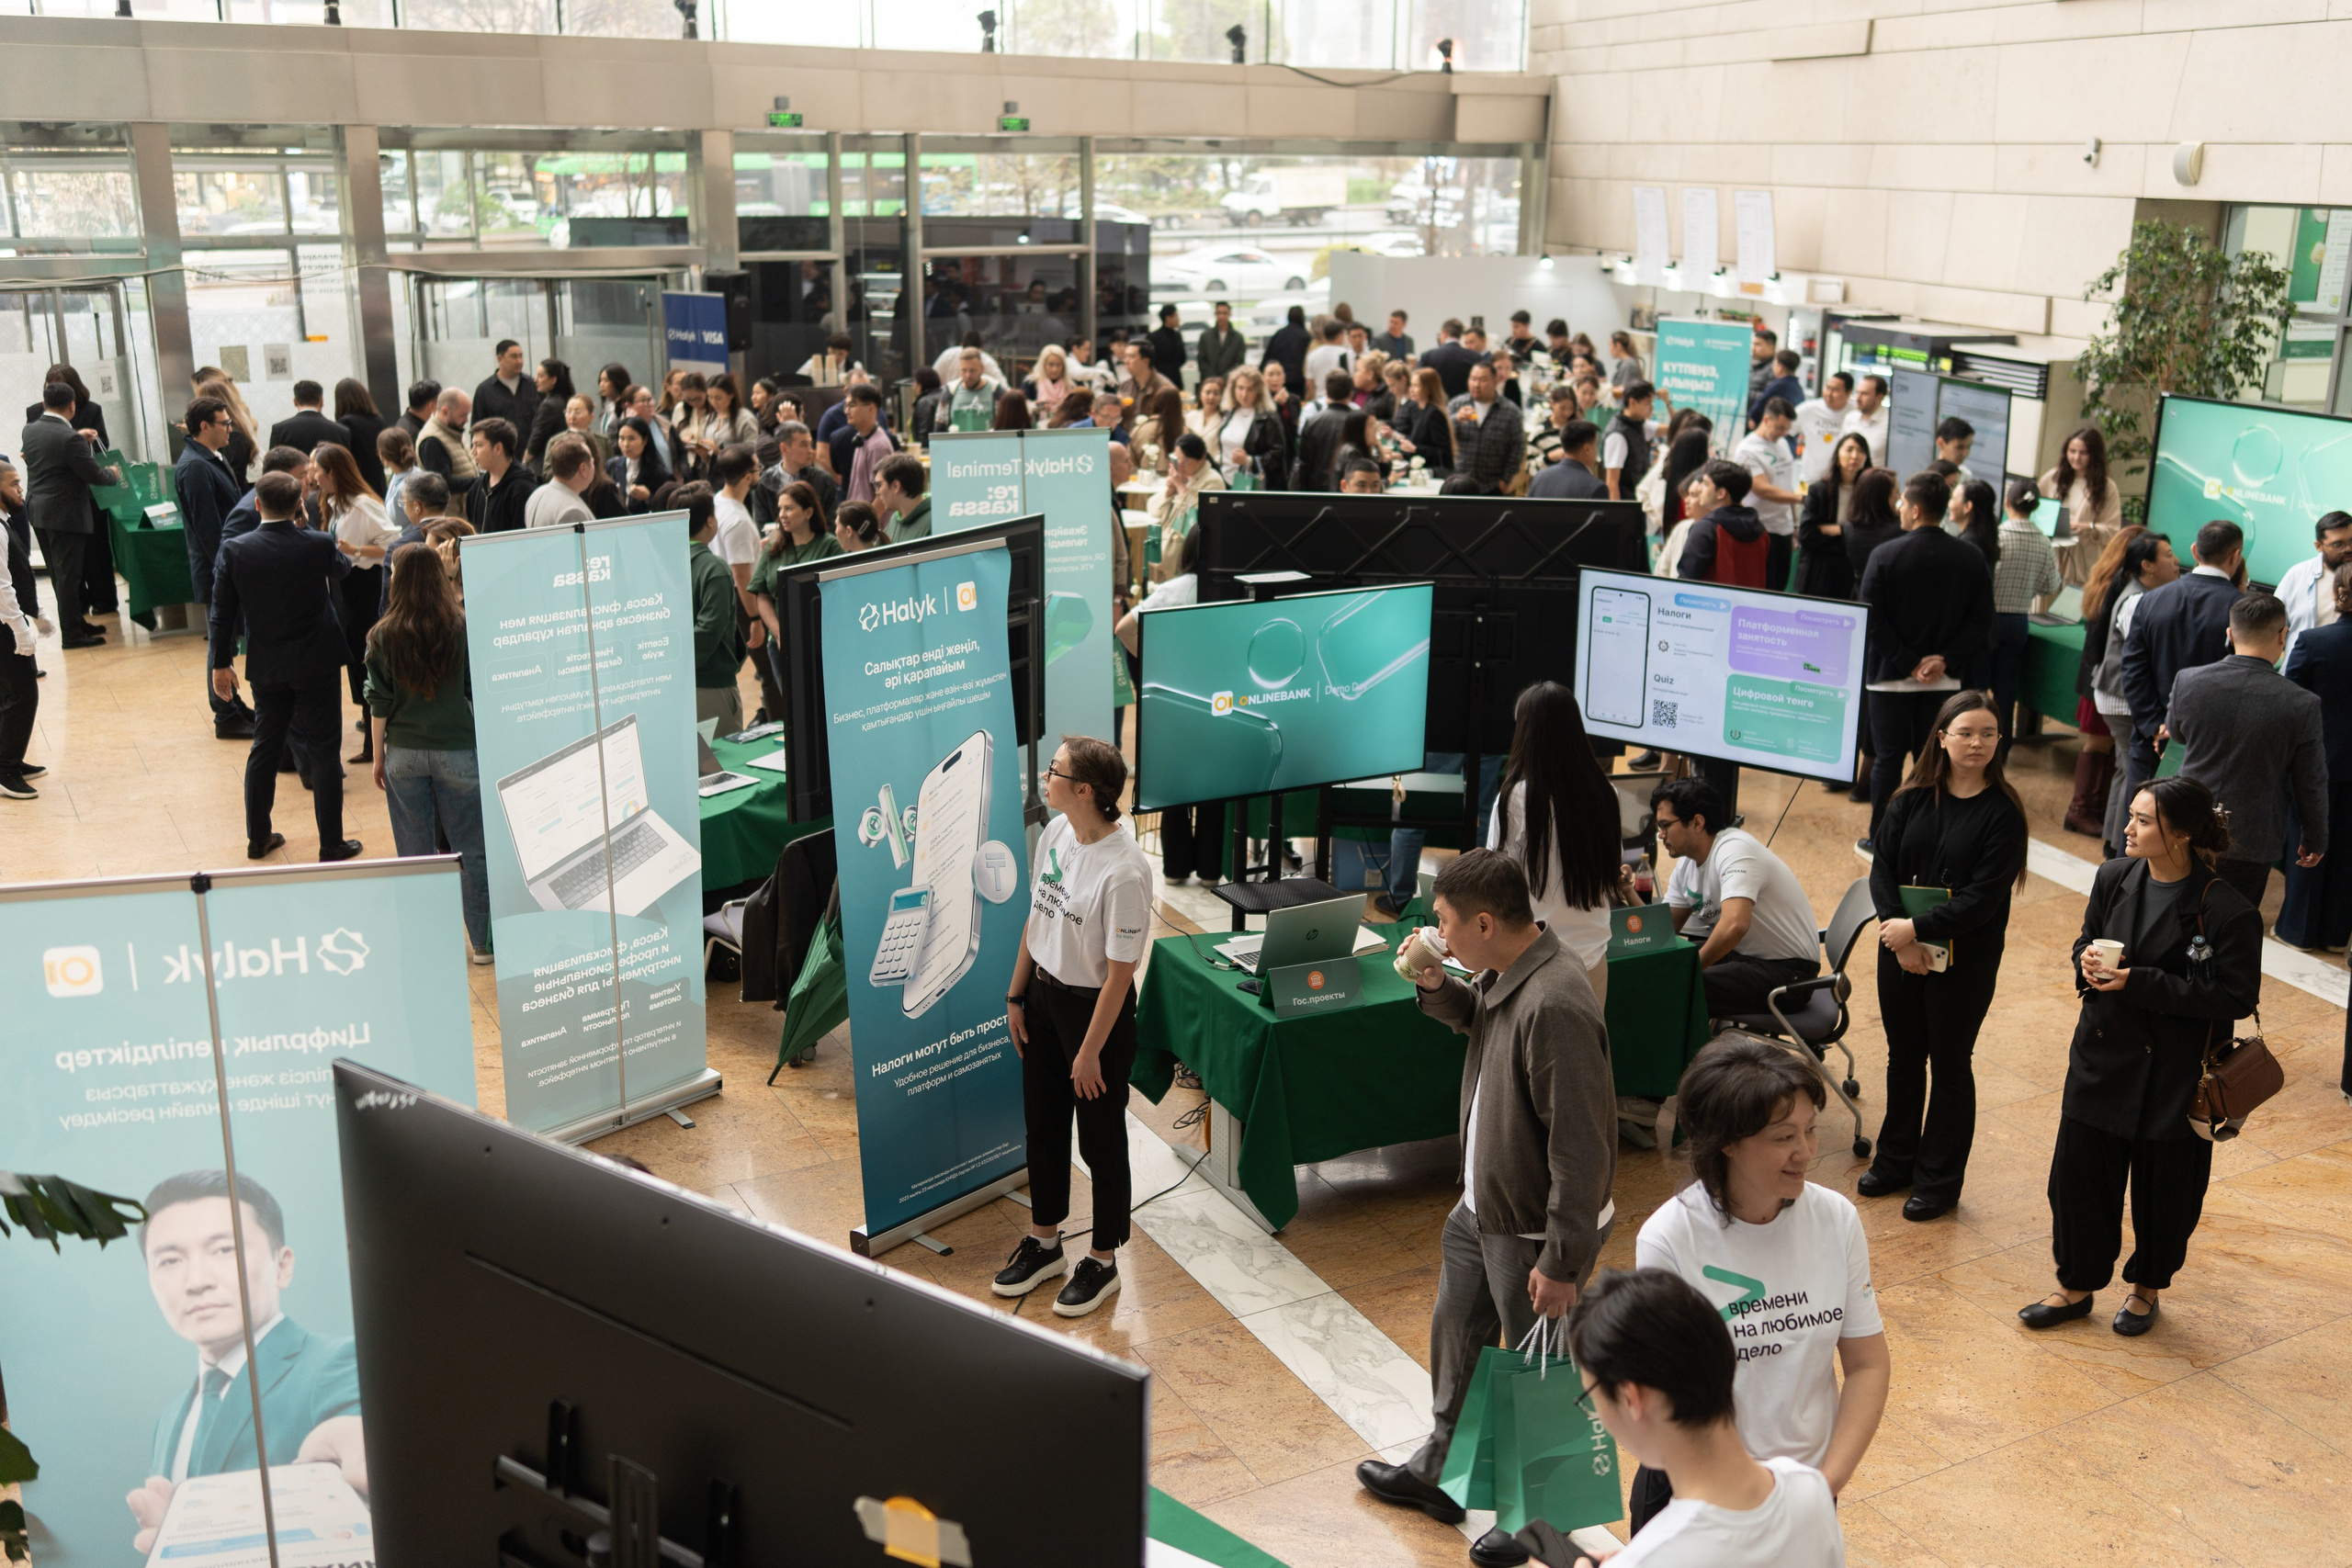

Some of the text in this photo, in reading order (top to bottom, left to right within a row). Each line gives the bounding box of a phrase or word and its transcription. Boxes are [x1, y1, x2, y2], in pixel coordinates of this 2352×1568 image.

[702, 331, 724, 344] VISA
[2226, 487, 2286, 506] ONLINEBANK
[882, 594, 937, 626] Halyk
[1657, 606, 1691, 620] Налоги
[1679, 596, 1717, 609] Посмотреть
[1737, 618, 1820, 639] Платформенная
[1800, 613, 1840, 626] Посмотреть
[1737, 630, 1788, 647] занятость
[865, 638, 980, 677] Салықтар енді жеңіл,
[885, 660, 966, 690] әрі қарапайым
[1654, 673, 1674, 685] Quiz
[833, 671, 1007, 725] Бизнес, платформалар және өзін-өзі жұмыспен
[1239, 688, 1311, 705] ONLINEBANK
[1325, 684, 1351, 695] Demo
[1733, 686, 1815, 709] Цифровой тенге
[1794, 683, 1835, 697] Посмотреть
[862, 691, 990, 732] қамтығандар үшін ыңғайлы шешім
[1042, 873, 1070, 902] времени
[1034, 900, 1055, 919] дело
[1038, 886, 1083, 926] на любимое
[1624, 936, 1651, 946] Налоги
[1293, 991, 1346, 1007] Гос.проекты
[872, 1014, 1009, 1077] Налоги могут быть прост
[894, 1034, 1012, 1089] Удобное решение для бизнеса,
[907, 1052, 1001, 1097] платформ и самозанятых
[899, 1195, 909, 1203] 2023
[1728, 1289, 1810, 1321] времени
[1734, 1307, 1844, 1339] на любимое
[1736, 1341, 1783, 1363] дело
